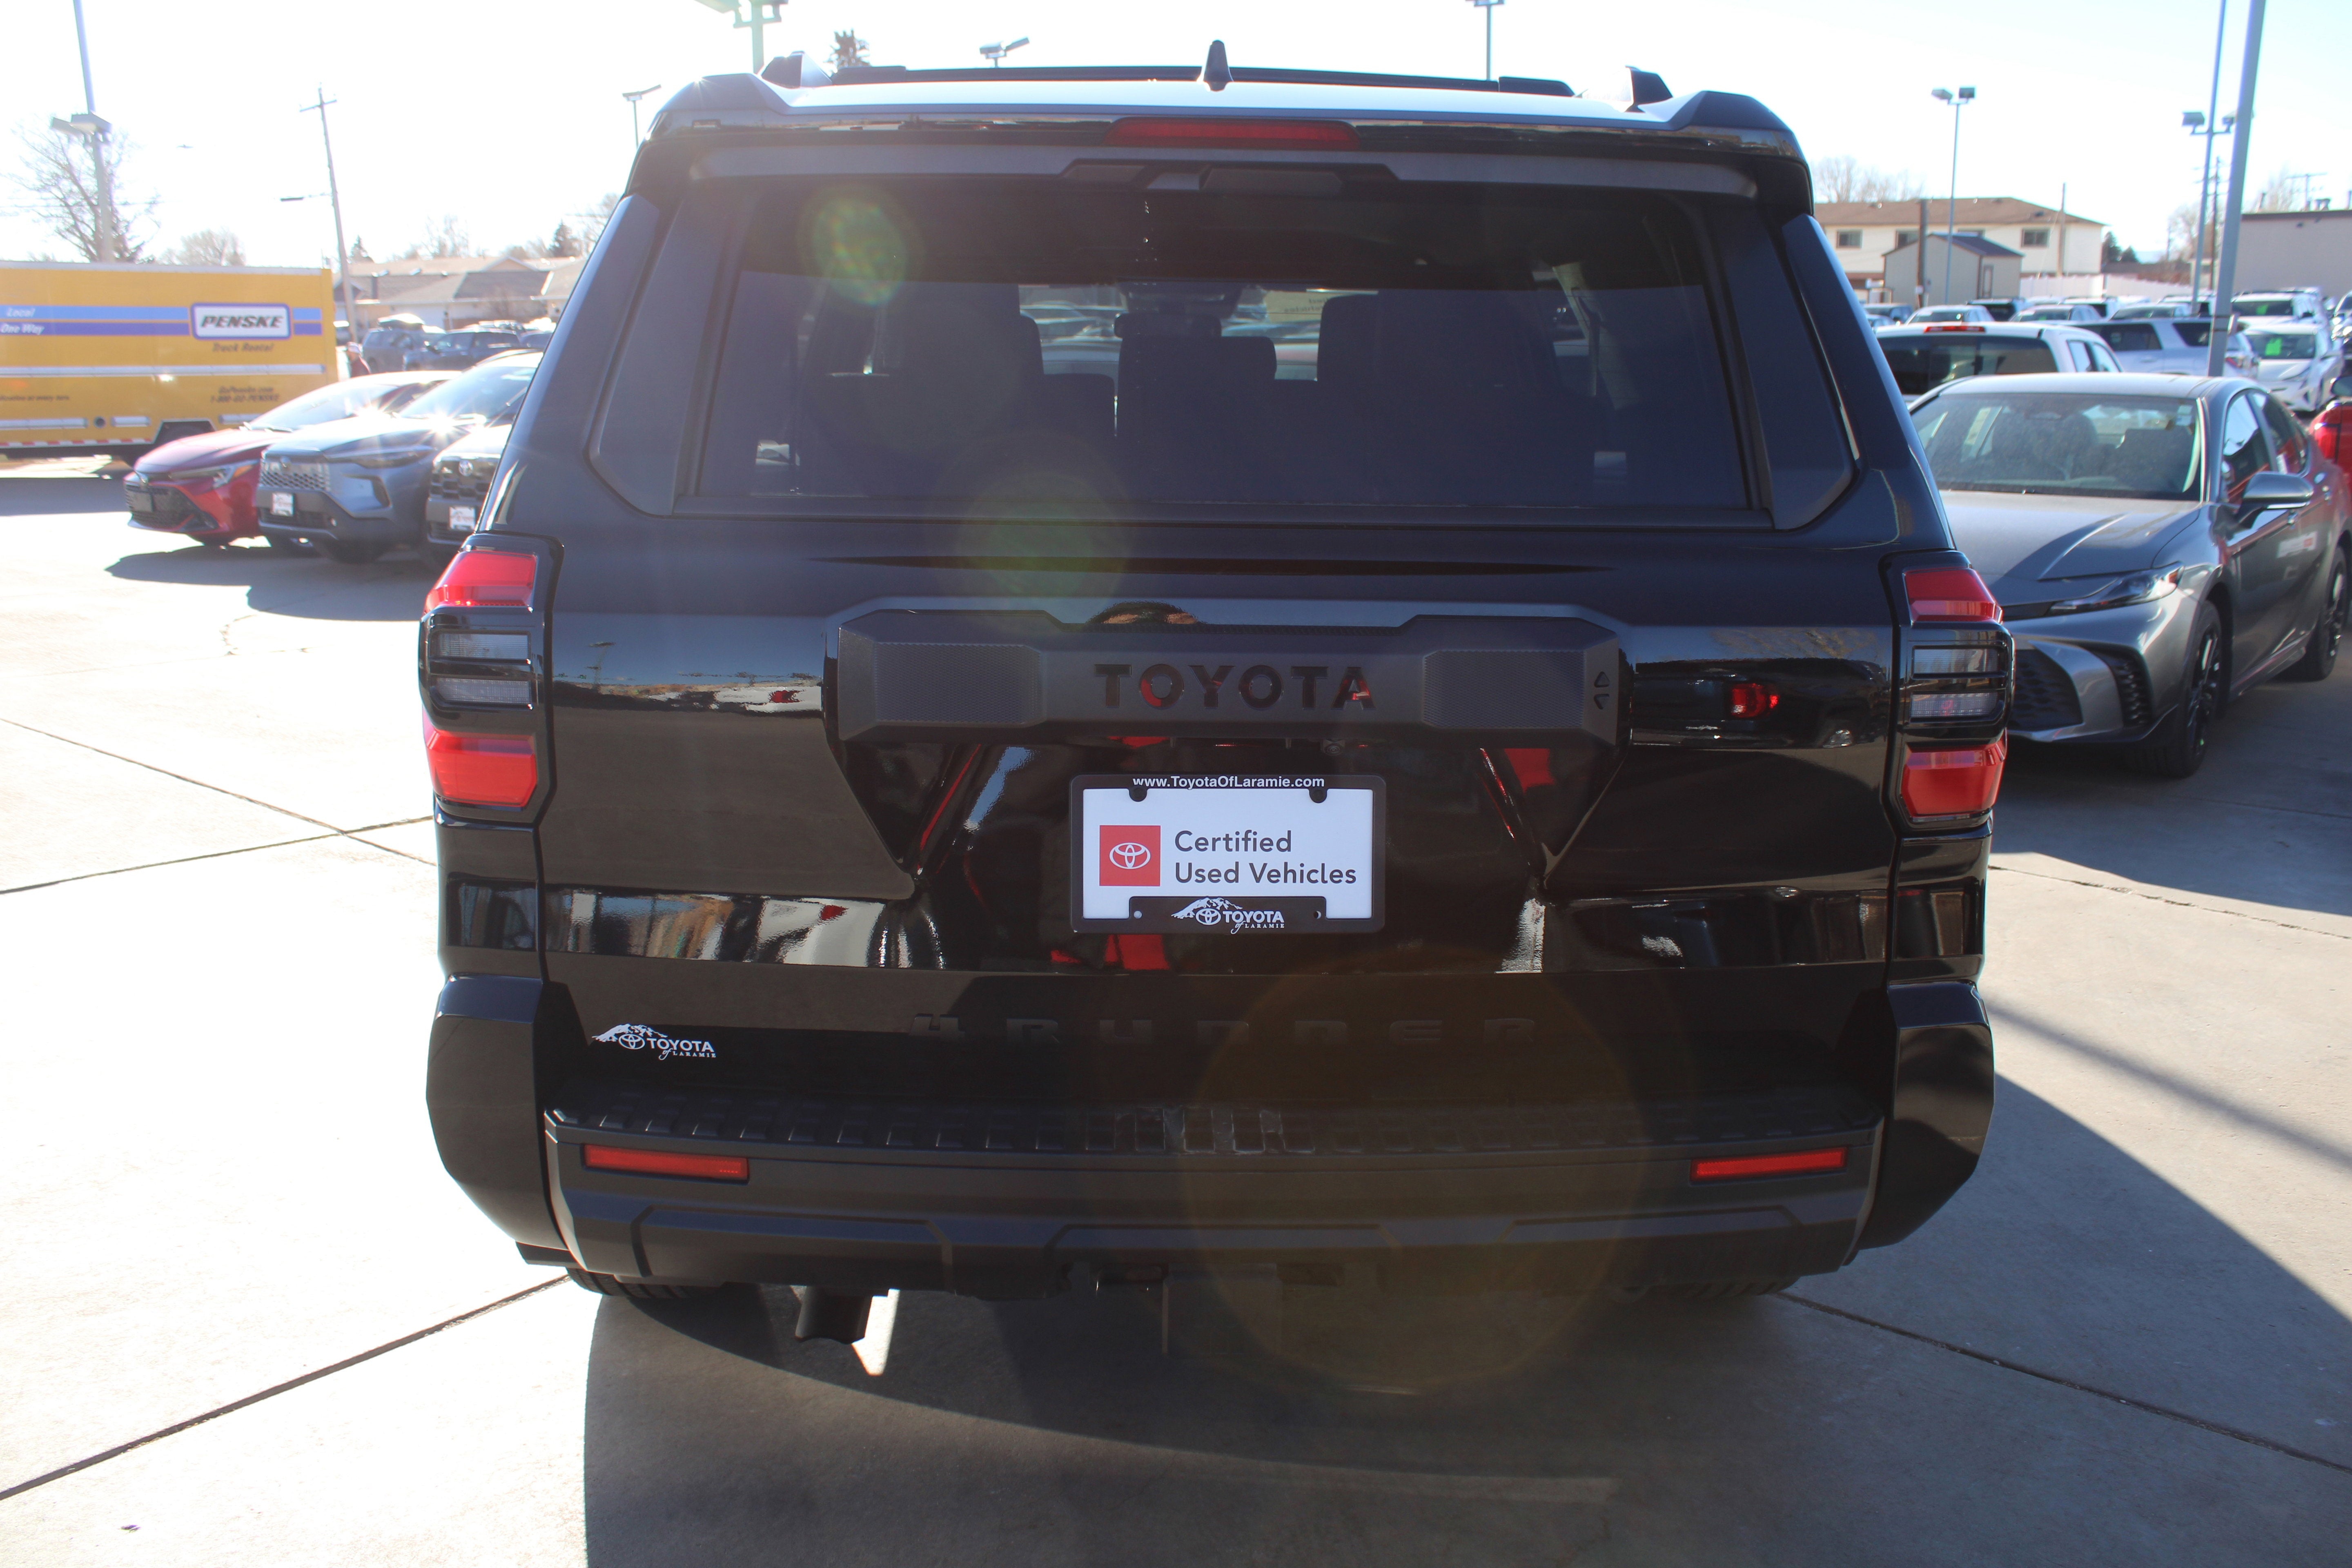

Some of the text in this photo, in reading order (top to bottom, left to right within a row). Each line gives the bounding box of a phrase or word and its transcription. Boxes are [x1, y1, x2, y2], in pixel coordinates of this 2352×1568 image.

[201, 315, 284, 328] PENSKE
[1094, 663, 1376, 710] TOYOTA
[1133, 775, 1324, 790] www.ToyotaOfLaramie.com
[1174, 829, 1292, 852] Certified
[1175, 862, 1356, 884] Used Vehicles
[1222, 911, 1285, 923] TOYOTA
[1230, 920, 1246, 935] of
[646, 1037, 715, 1053] TOYOTA
[658, 1048, 673, 1060] of
